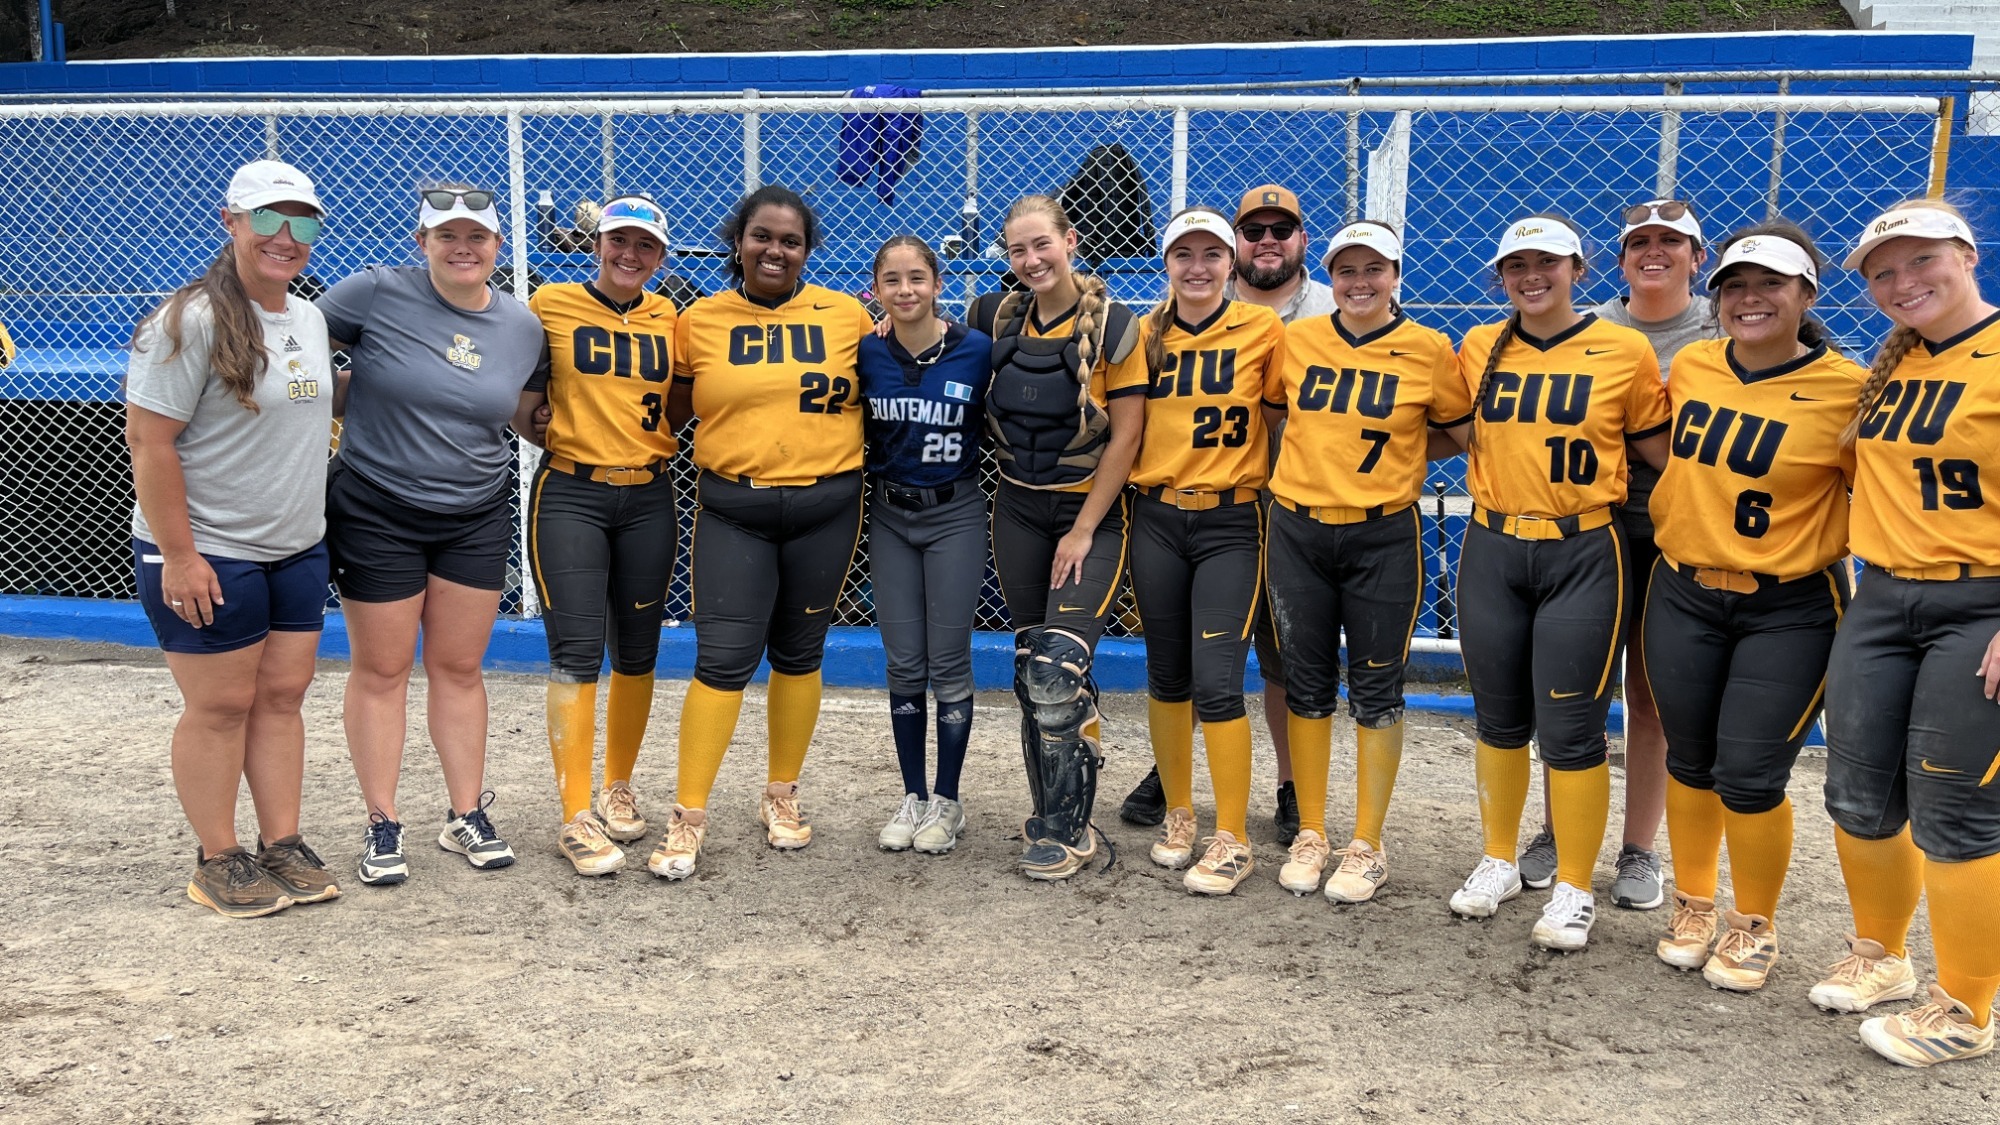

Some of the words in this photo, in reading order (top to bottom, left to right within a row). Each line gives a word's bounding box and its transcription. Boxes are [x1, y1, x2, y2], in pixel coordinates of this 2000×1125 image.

[1185, 216, 1210, 227] Rams
[1346, 230, 1373, 240] Rams
[1515, 226, 1543, 241] Rams
[1874, 218, 1909, 236] Rams
[446, 347, 482, 369] CIU
[573, 325, 670, 383] CIU
[728, 323, 827, 366] CIU
[287, 380, 319, 400] CIU
[799, 371, 851, 414] 22
[1145, 348, 1237, 400] CIU
[1297, 364, 1400, 420] CIU
[640, 392, 662, 432] 3
[869, 397, 964, 427] GUATEMALA
[1481, 371, 1594, 426] CIU
[1858, 379, 1968, 446] CIU
[921, 431, 963, 463] 26
[1192, 405, 1250, 449] 23
[1672, 399, 1789, 479] CIU
[1356, 428, 1392, 474] 7
[1545, 436, 1599, 486] 10
[1912, 456, 1985, 511] 19
[1733, 489, 1774, 539] 6
